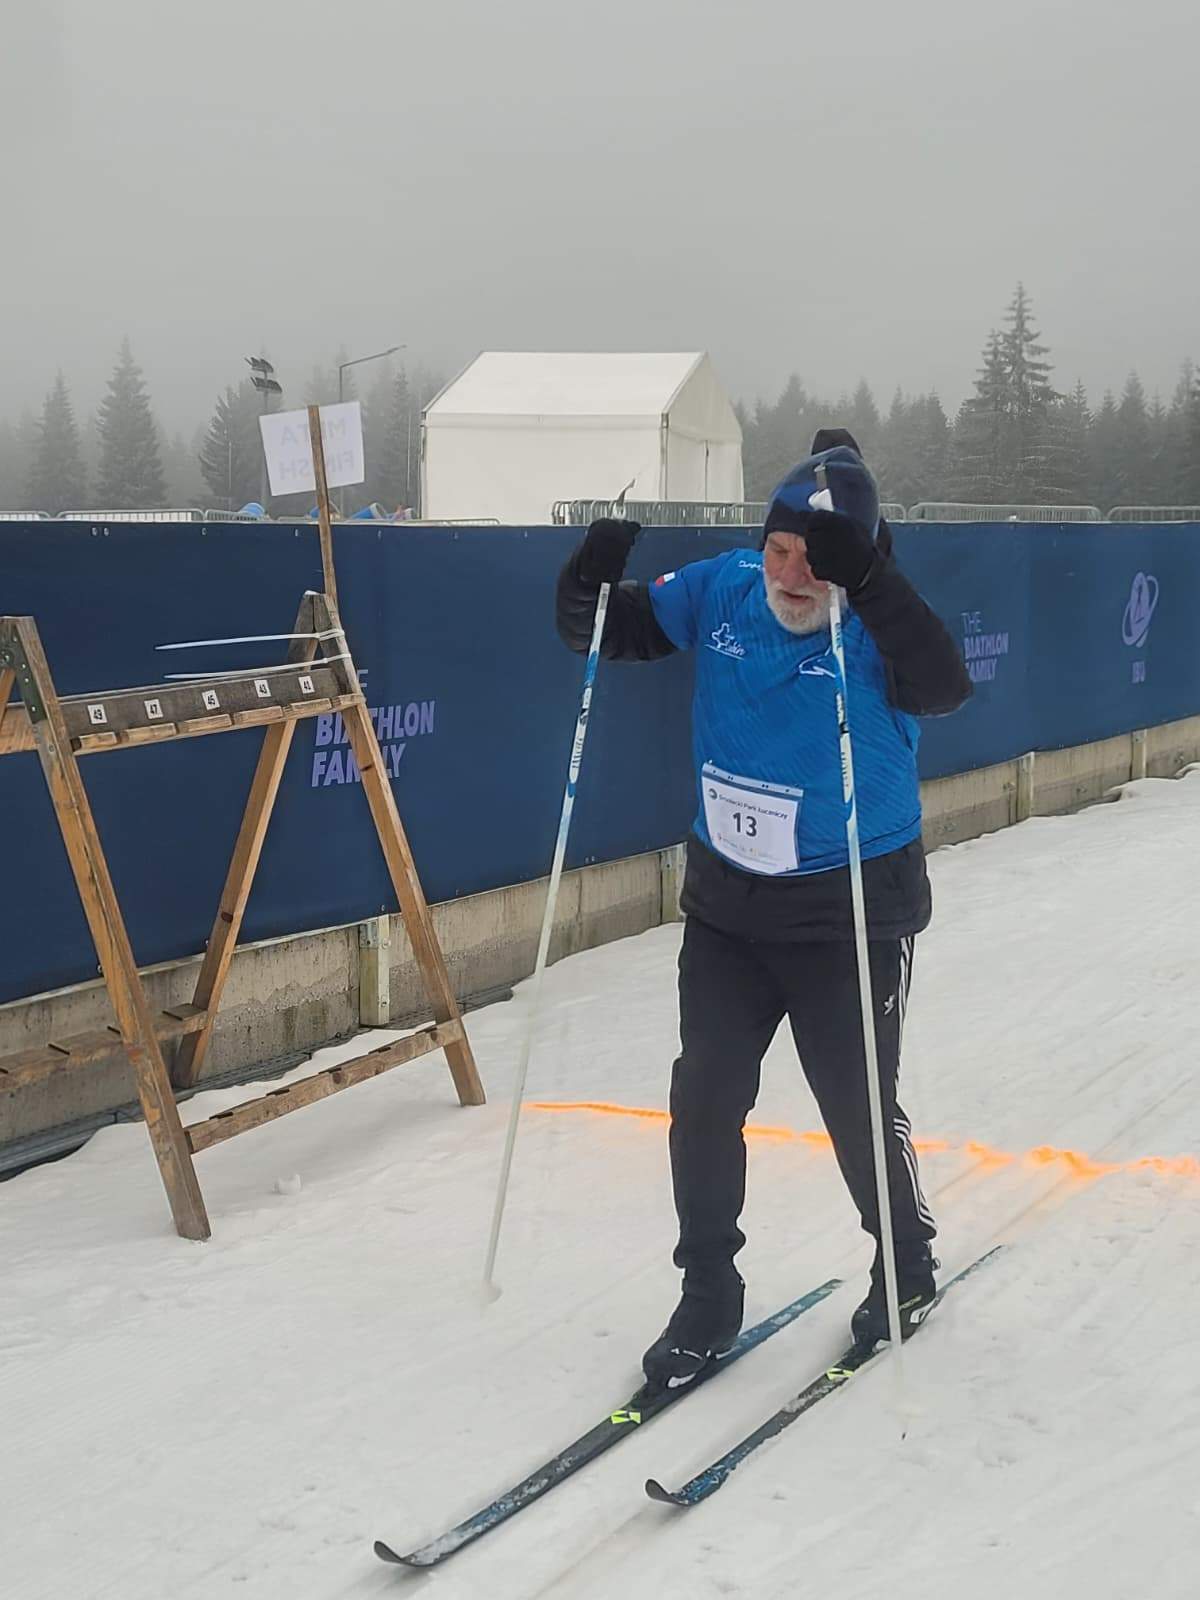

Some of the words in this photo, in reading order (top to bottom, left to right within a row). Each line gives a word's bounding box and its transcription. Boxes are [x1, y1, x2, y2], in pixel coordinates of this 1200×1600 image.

[961, 611, 982, 635] THE
[964, 632, 1009, 660] BIATHLON
[315, 701, 435, 746] BIHLON
[311, 743, 406, 787] FAMLY
[733, 812, 757, 837] 13
